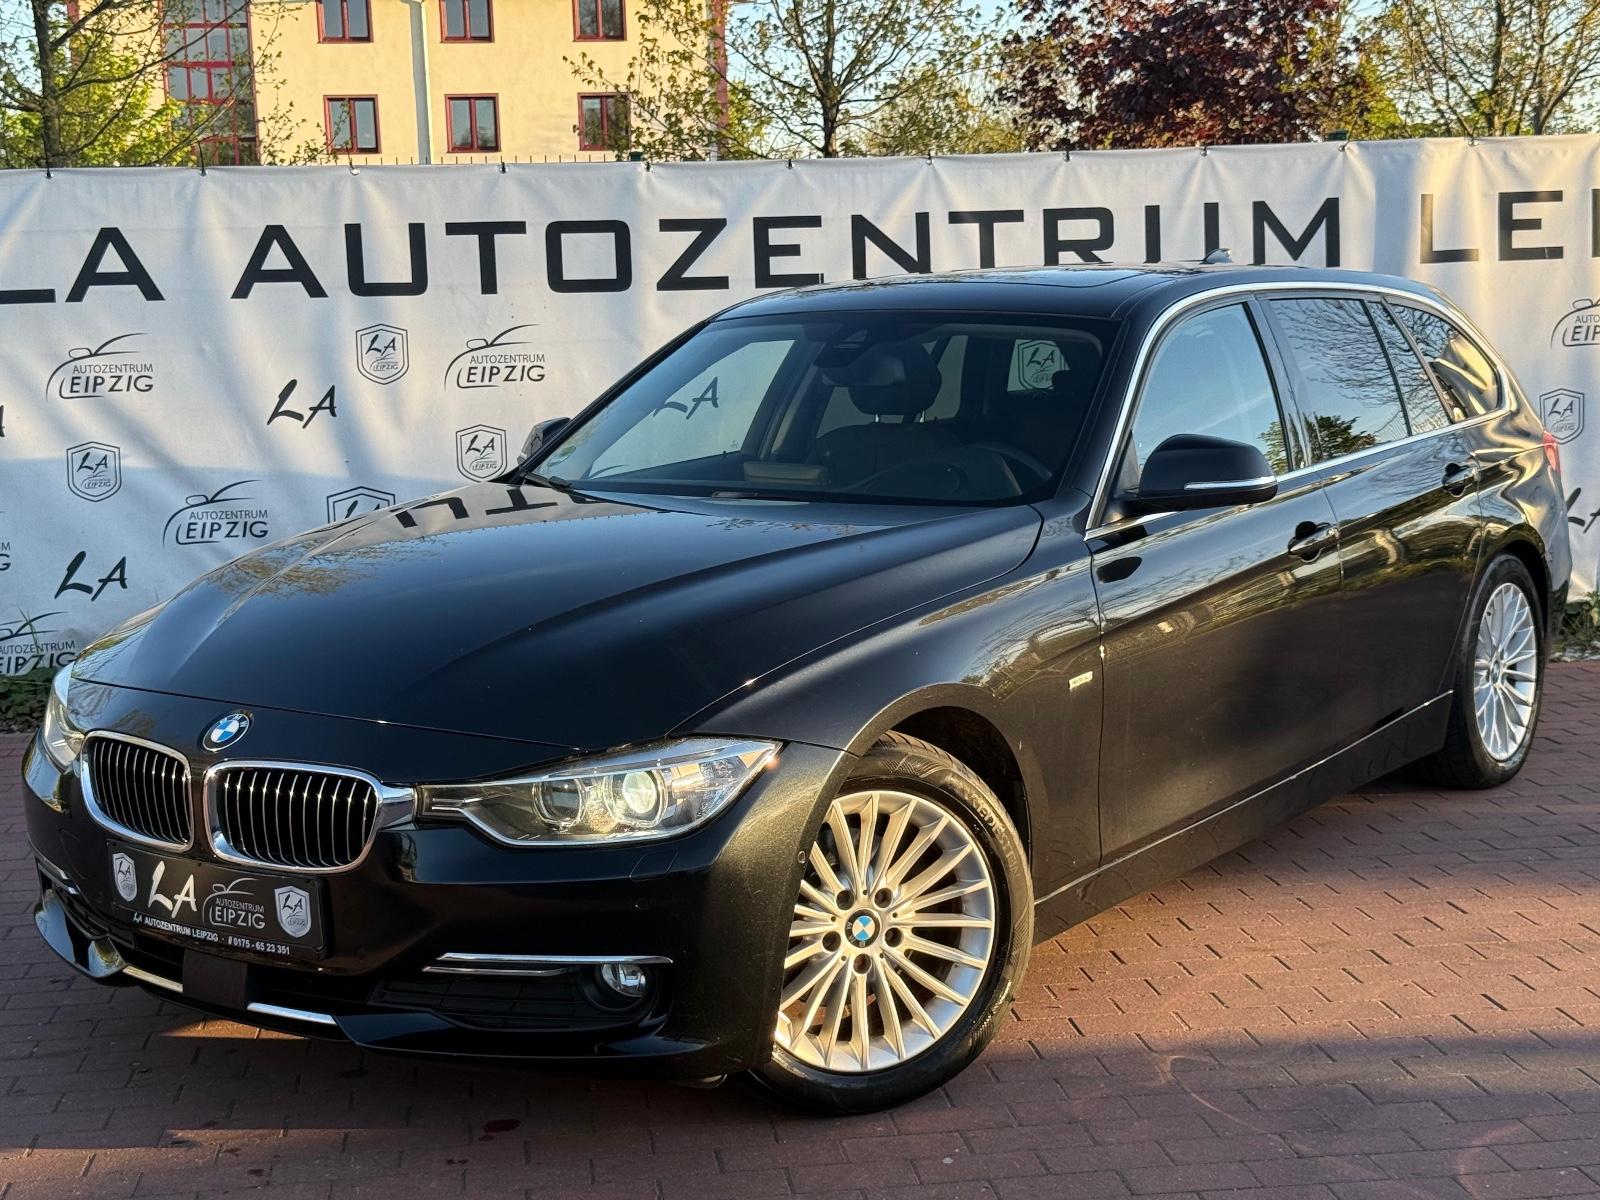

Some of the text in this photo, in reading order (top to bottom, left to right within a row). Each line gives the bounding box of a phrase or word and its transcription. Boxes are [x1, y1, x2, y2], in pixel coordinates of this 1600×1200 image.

[231, 197, 1340, 300] AUTOZENTRUM
[365, 333, 397, 357] LA
[72, 363, 154, 375] AUTOZENTRUM
[470, 354, 546, 364] AUTOZENTRUM
[267, 379, 337, 429] LA
[1547, 398, 1574, 418] LA
[465, 434, 496, 456] LA
[76, 451, 109, 474] LA
[189, 509, 268, 520] AUTOZENTRUM
[54, 550, 128, 602] LA
[148, 860, 197, 918] LA
[215, 897, 265, 913] AUTOZENTRUM
[282, 894, 303, 913] LA
[144, 916, 191, 936] AUTOZENTRUM
[191, 928, 219, 942] LEIPZIG
[255, 941, 266, 951] 65
[276, 944, 290, 955] 351
